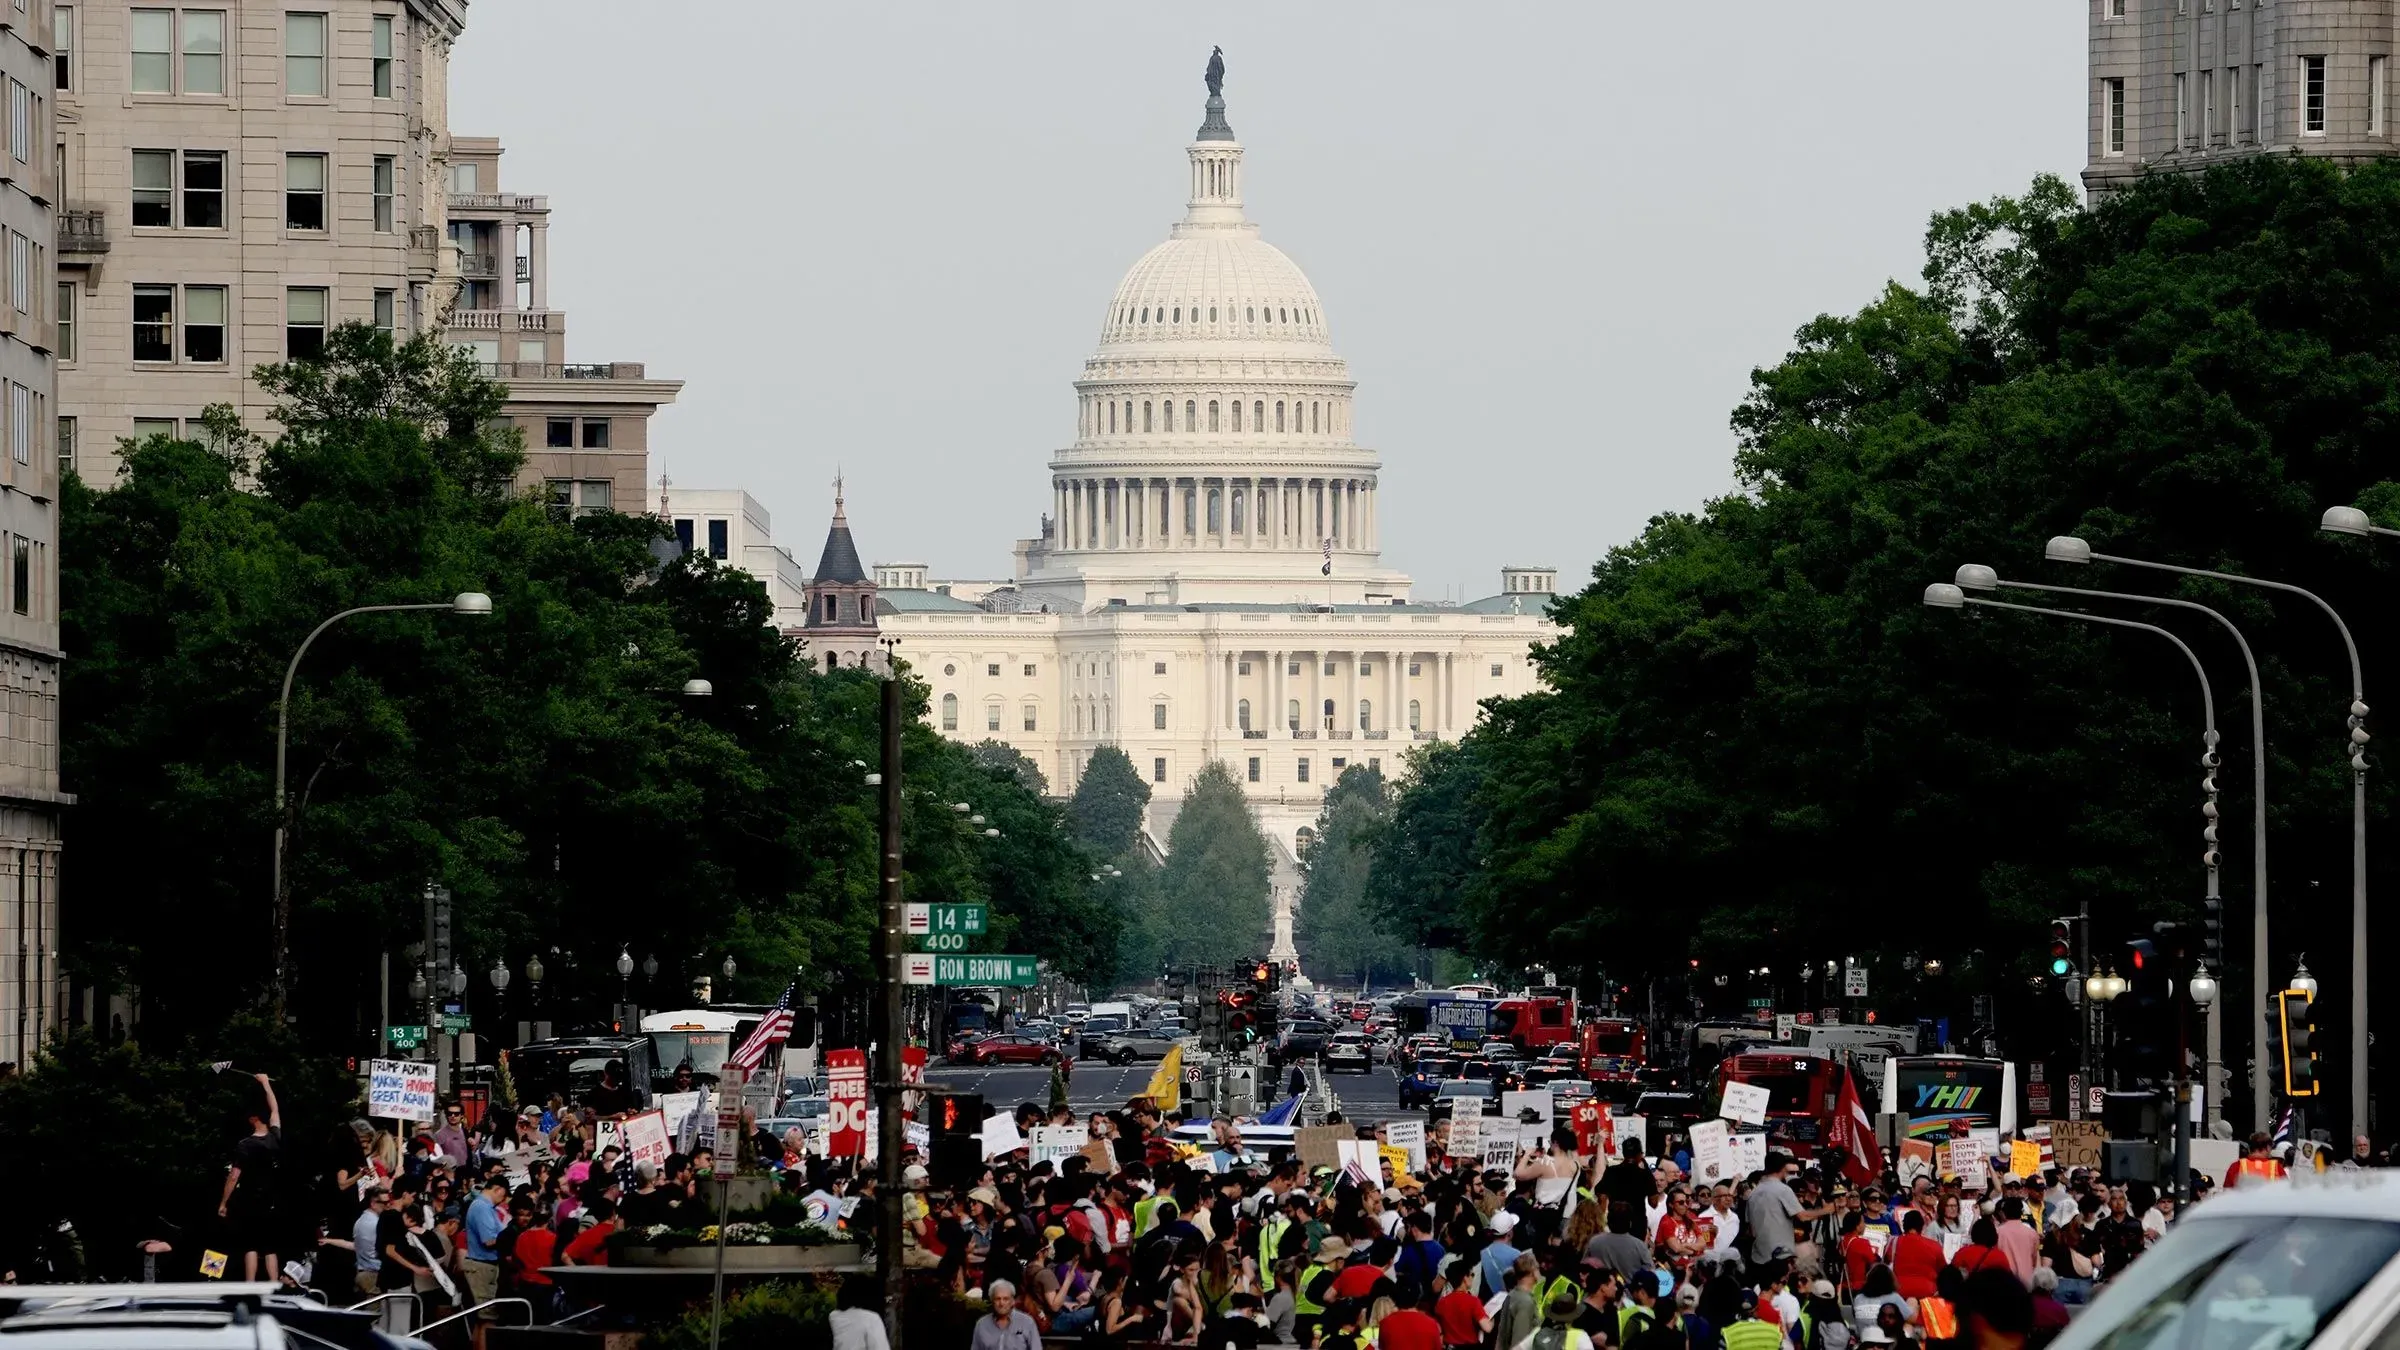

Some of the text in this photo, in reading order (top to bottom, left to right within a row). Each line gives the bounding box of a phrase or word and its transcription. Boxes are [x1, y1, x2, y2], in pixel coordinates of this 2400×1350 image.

[937, 908, 979, 931] 14 ST NW
[927, 933, 963, 949] 400
[940, 959, 1031, 981] RON BROWN WAY
[1438, 1008, 1487, 1026] AMERICA'S FIRM
[391, 1028, 405, 1038] 13
[396, 1039, 415, 1048] 400
[371, 1060, 400, 1073] TRUMP
[1794, 1060, 1807, 1071] 32
[829, 1079, 866, 1100] FREE
[371, 1090, 429, 1107] GREAT AGAIN
[829, 1099, 866, 1134] DC
[1392, 1137, 1418, 1145] CONVICT
[1488, 1141, 1514, 1150] HANDS
[2058, 1138, 2082, 1147] THE
[1380, 1147, 1406, 1156] CLIMATE
[1486, 1151, 1513, 1165] OFF!
